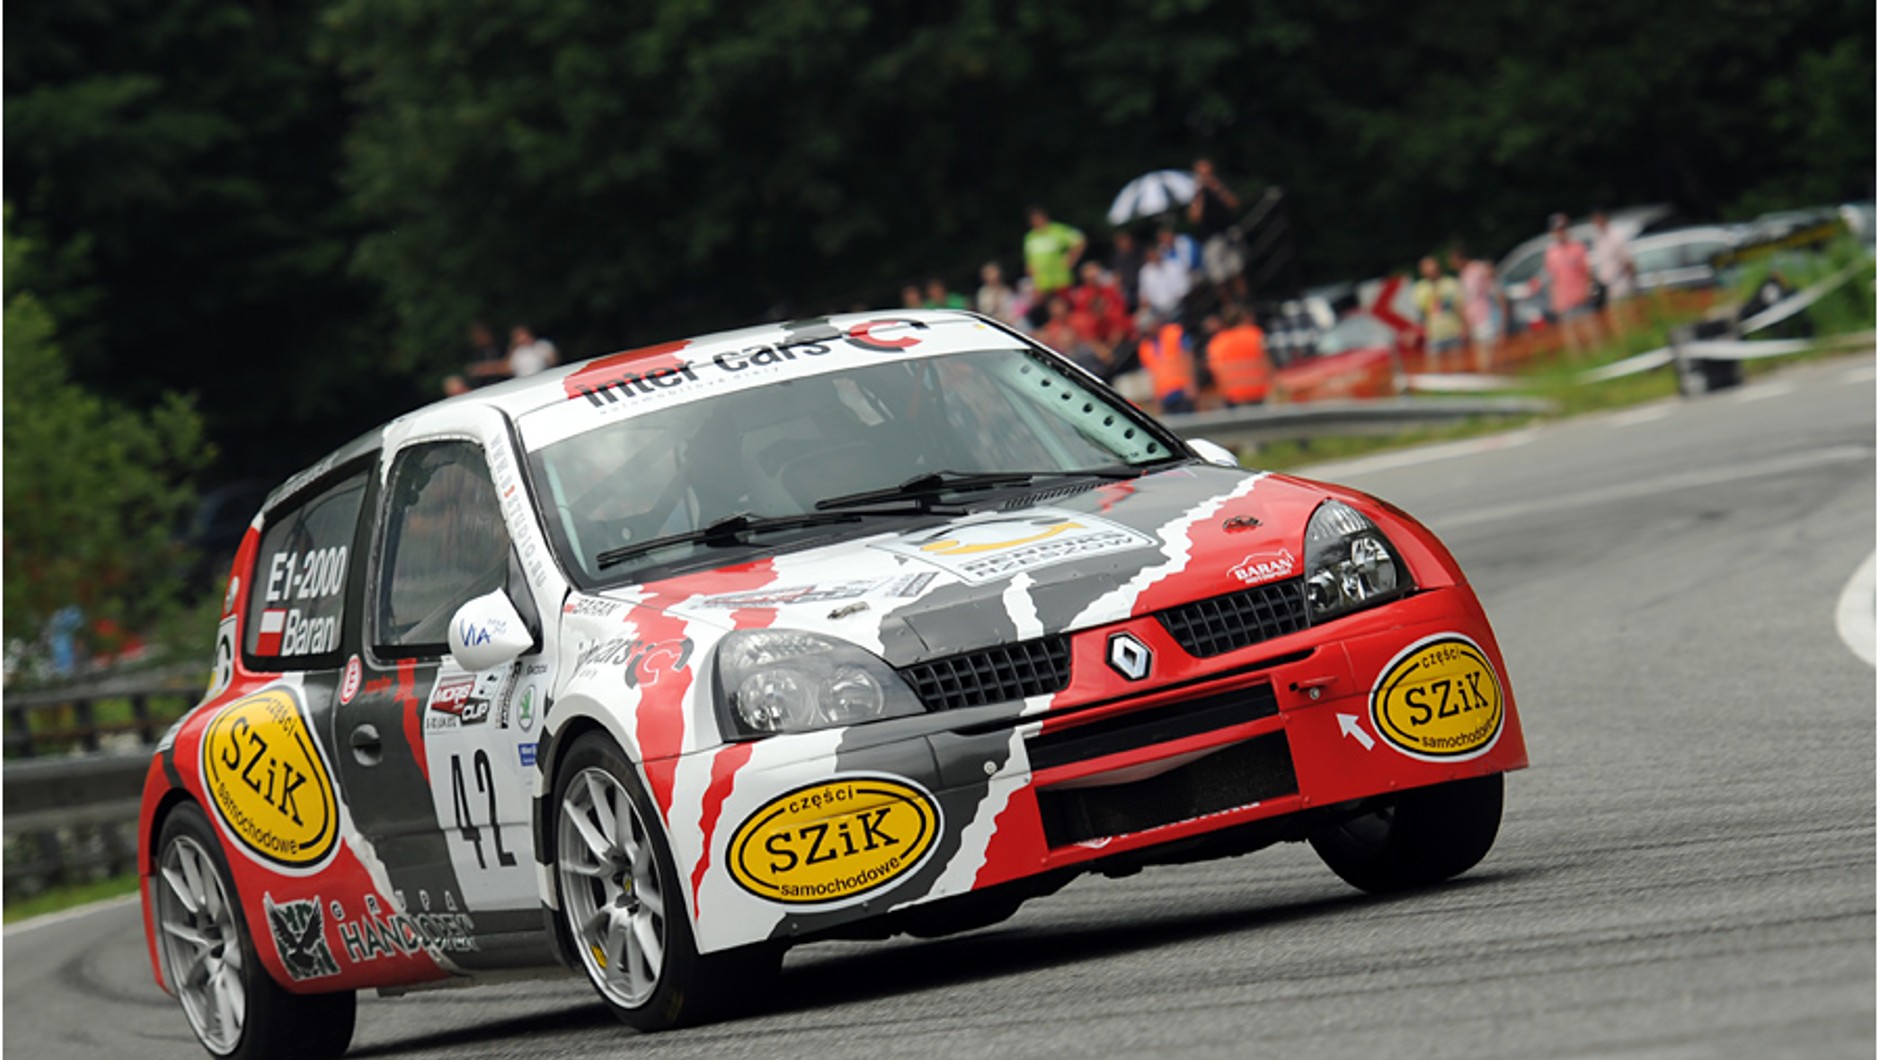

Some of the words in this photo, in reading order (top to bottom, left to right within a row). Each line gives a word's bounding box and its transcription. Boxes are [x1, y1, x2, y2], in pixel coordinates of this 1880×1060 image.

[575, 360, 700, 408] inter
[713, 338, 831, 373] cars
[265, 545, 347, 602] E1-2000
[1234, 559, 1293, 581] BARAN
[281, 608, 335, 657] Baran
[460, 618, 491, 648] VIA
[1422, 644, 1461, 669] części
[462, 701, 489, 721] CUP
[1404, 671, 1489, 727] SZiK
[221, 716, 306, 827] SZiK
[217, 783, 298, 855] samochodowe
[451, 749, 517, 870] 42
[789, 785, 854, 814] części
[764, 807, 899, 874] SZiK
[781, 856, 900, 896] samochodowe
